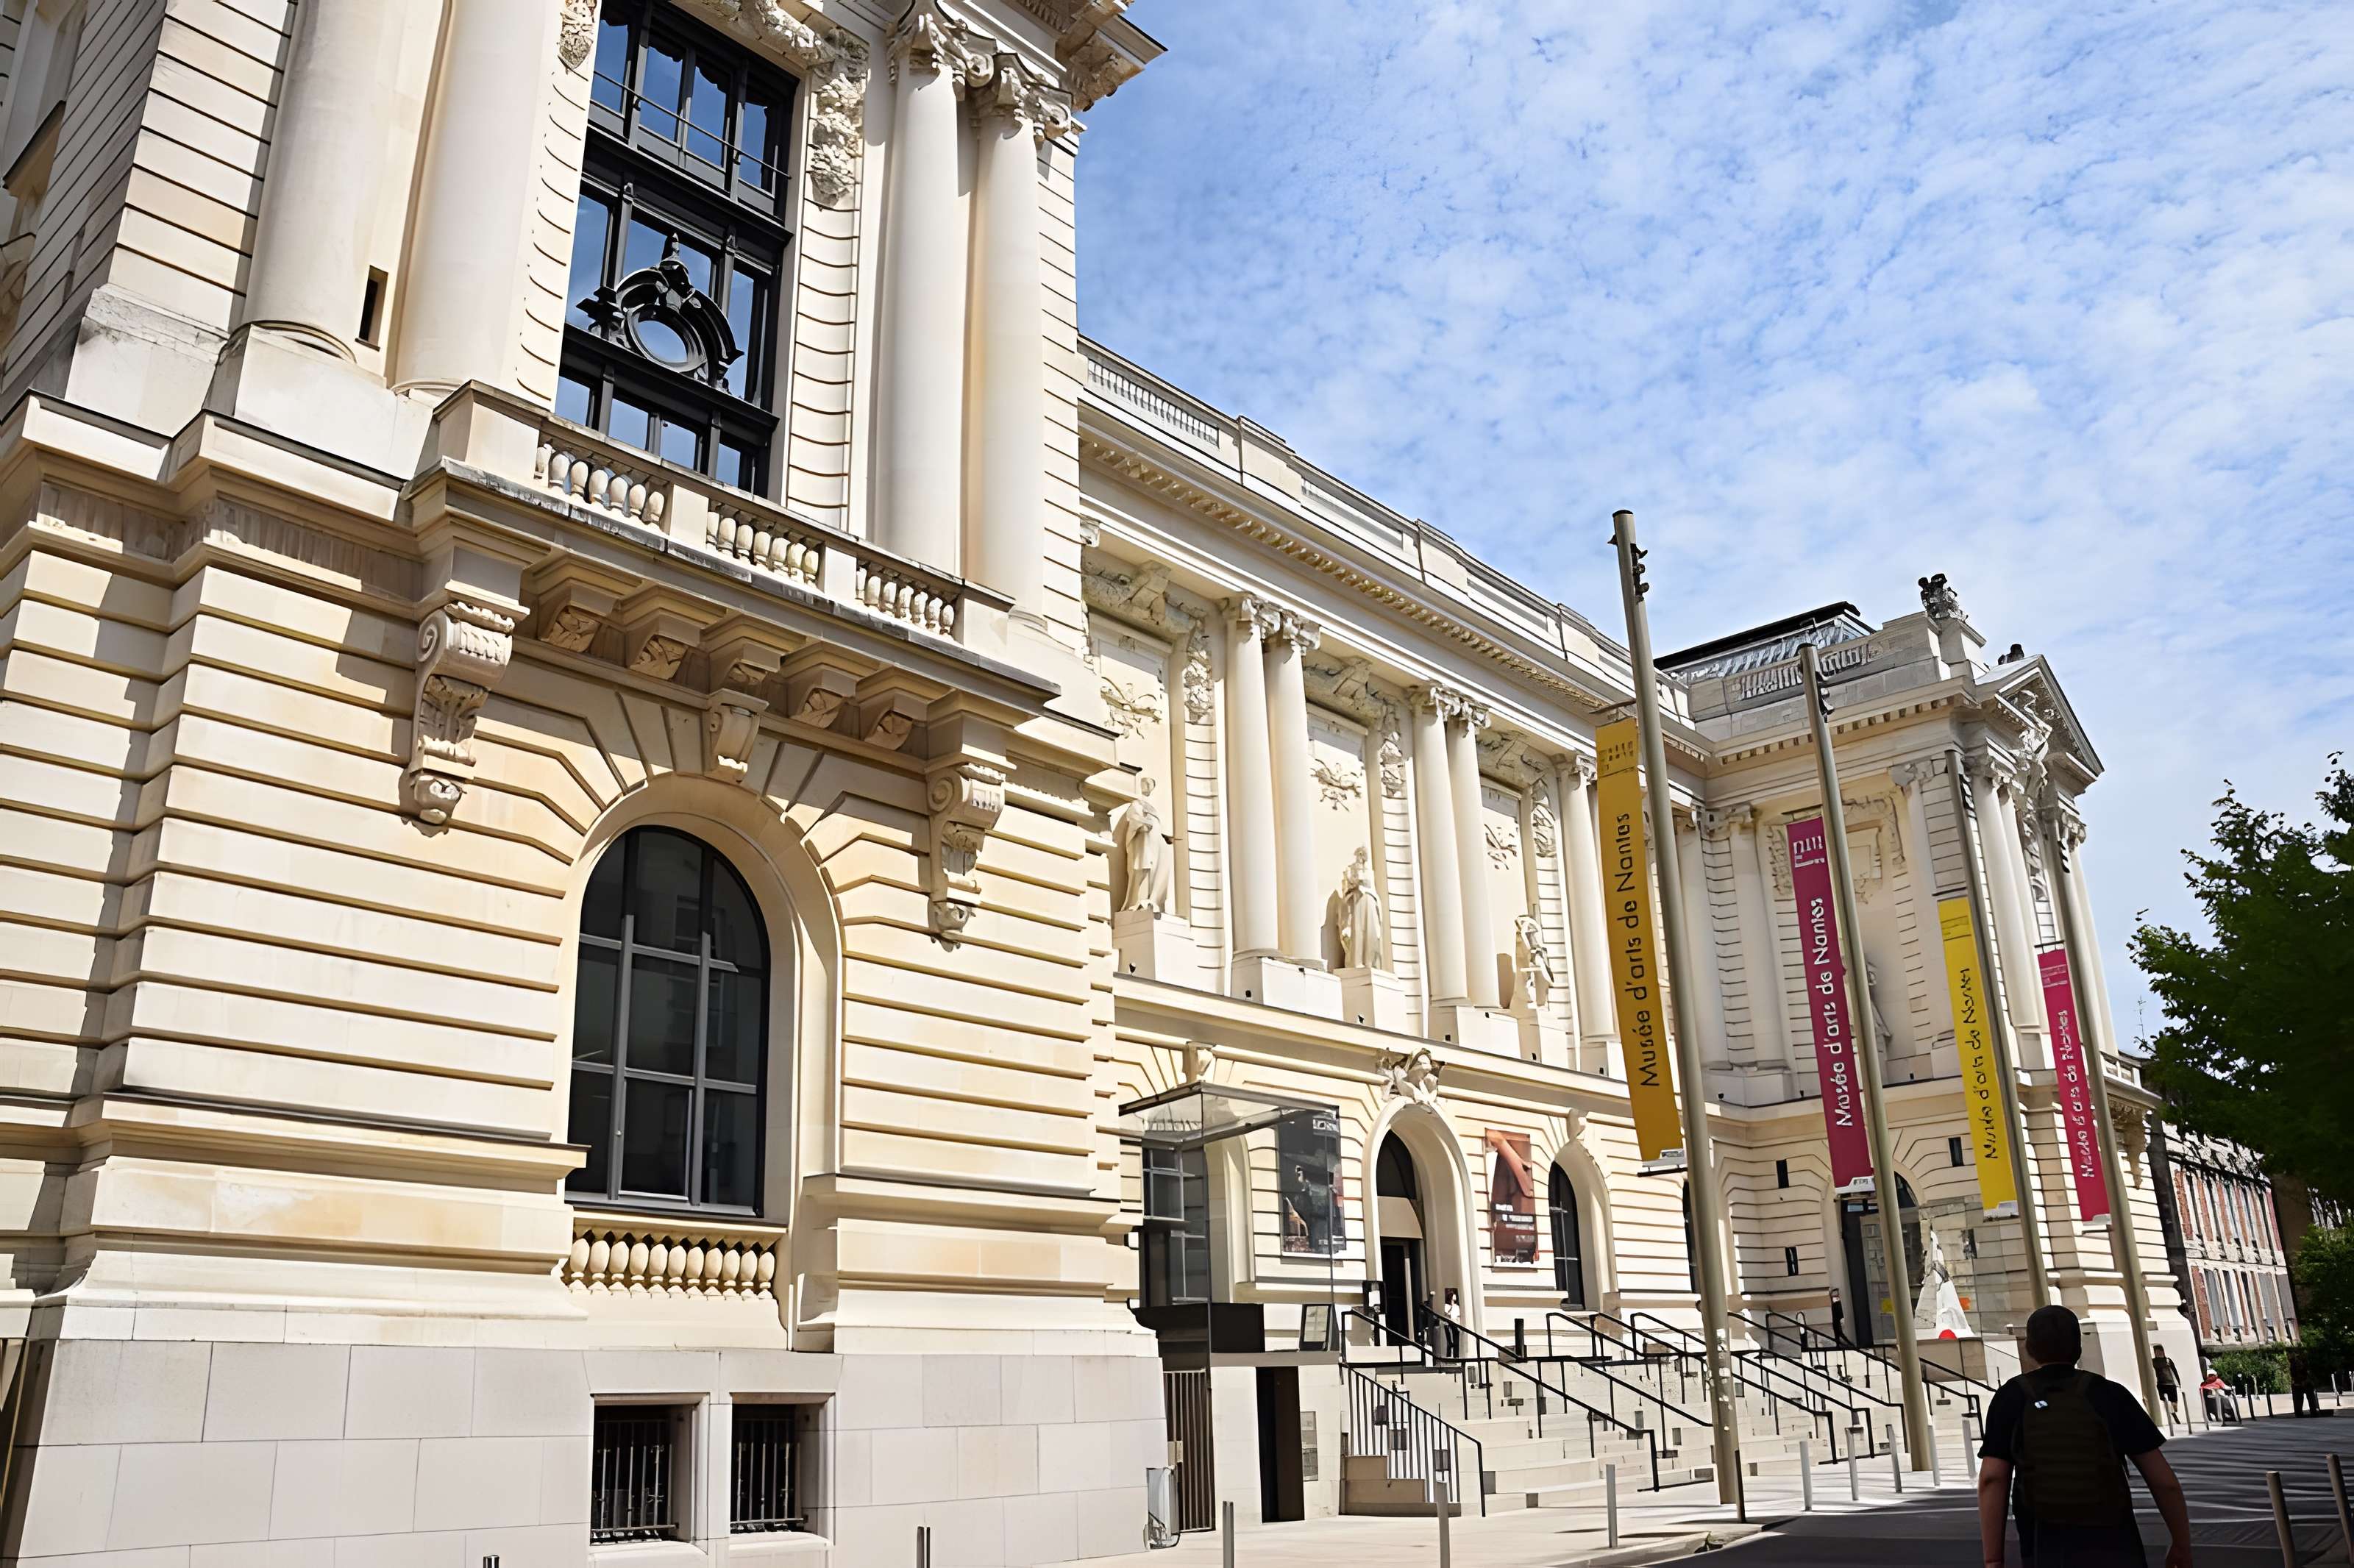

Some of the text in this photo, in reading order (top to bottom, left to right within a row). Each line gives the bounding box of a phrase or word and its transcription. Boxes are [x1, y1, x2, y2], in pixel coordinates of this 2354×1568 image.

[1615, 813, 1660, 1087] Musée d'arts de Nantes
[1811, 898, 1853, 1127] Musée d'arts de Nantes
